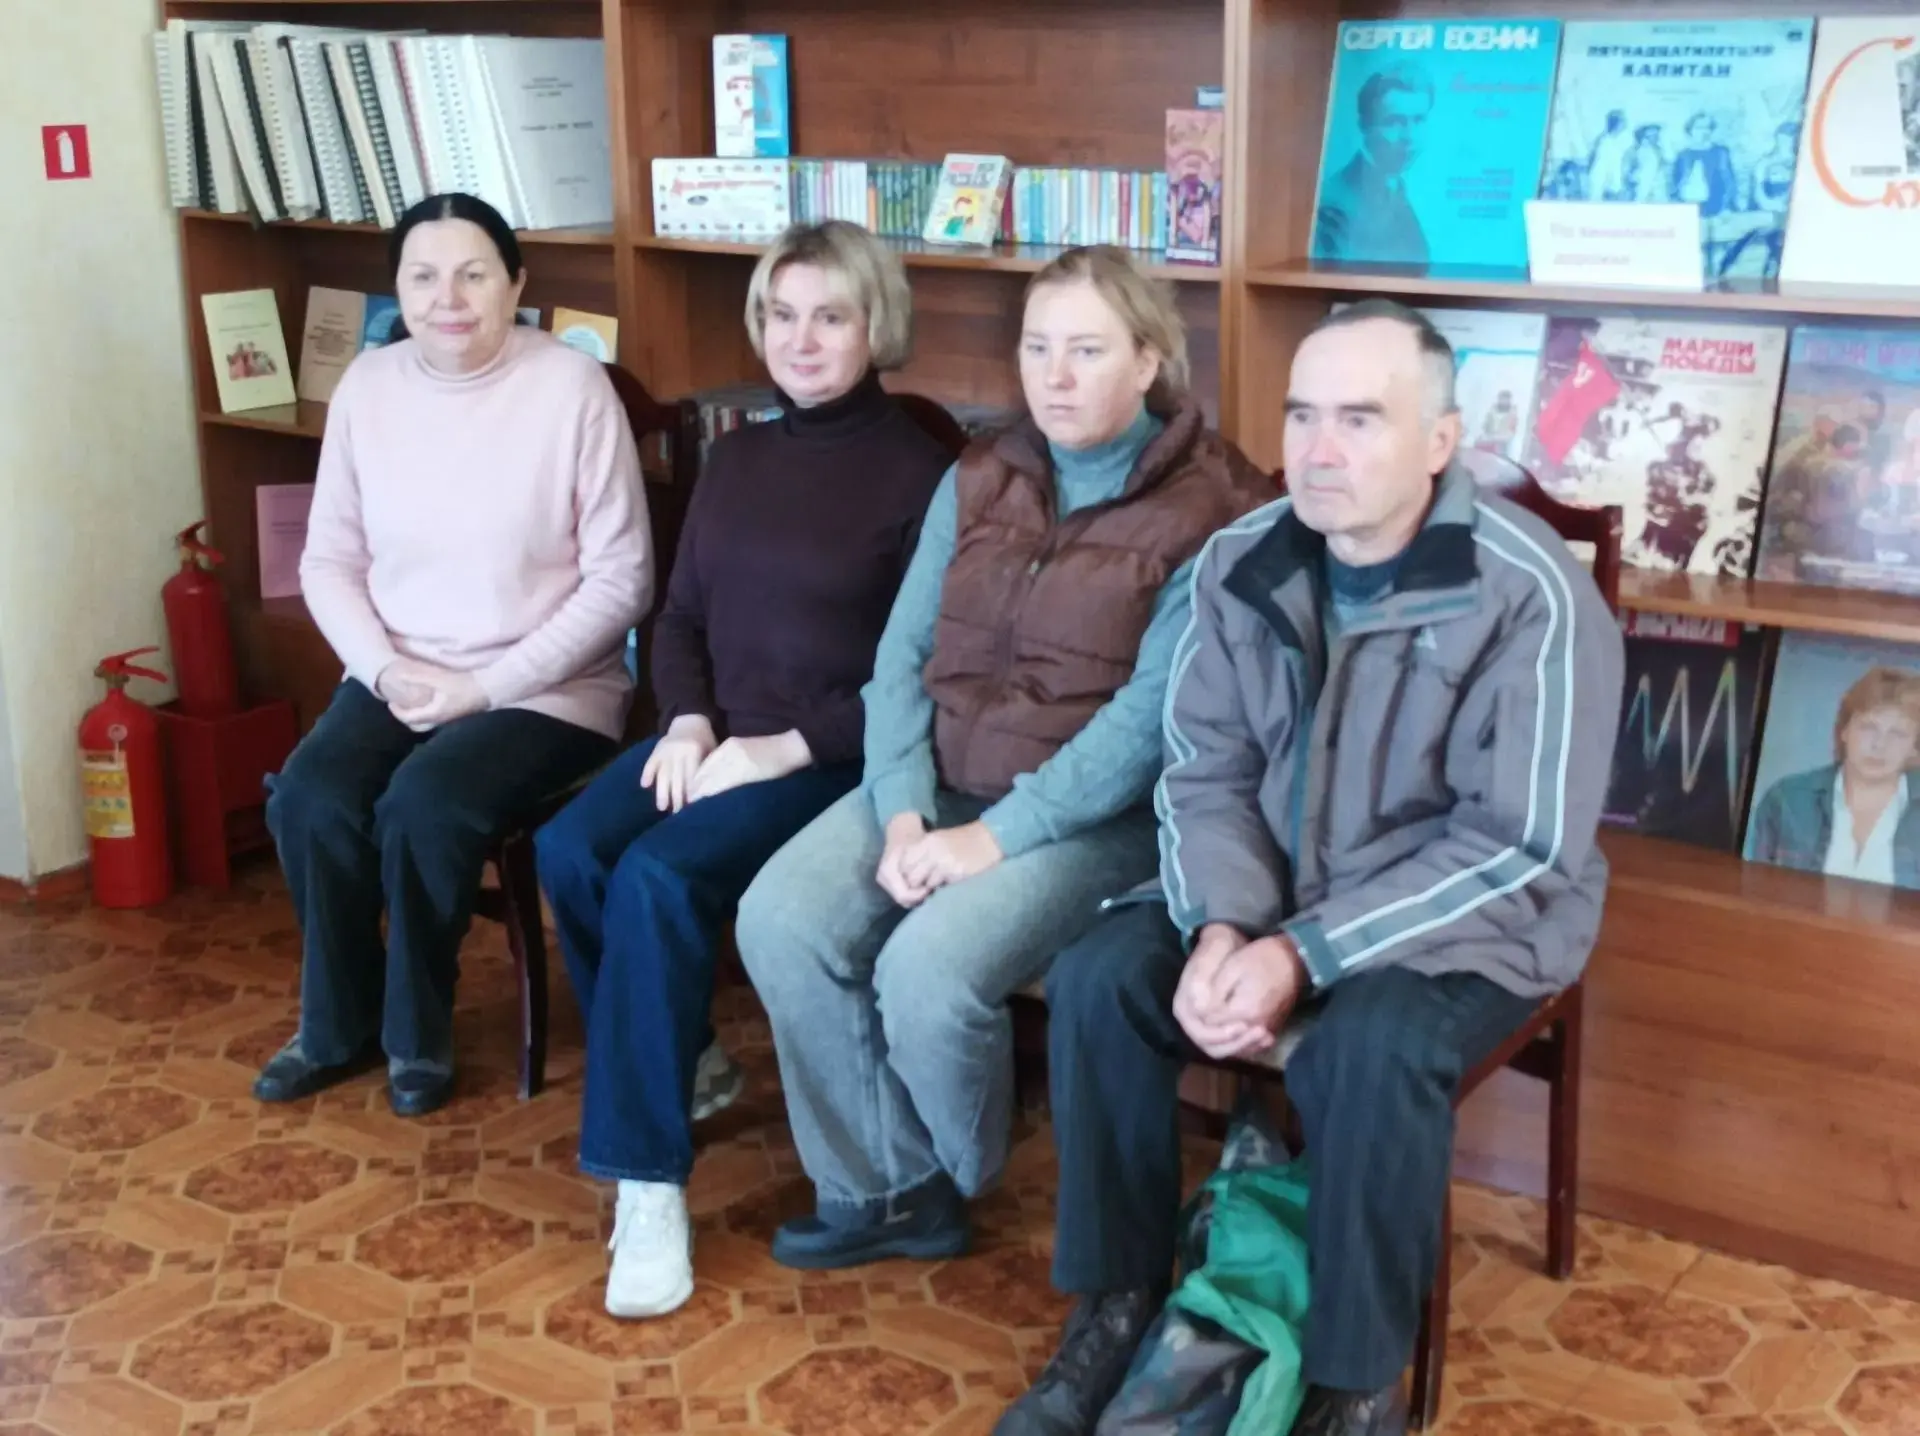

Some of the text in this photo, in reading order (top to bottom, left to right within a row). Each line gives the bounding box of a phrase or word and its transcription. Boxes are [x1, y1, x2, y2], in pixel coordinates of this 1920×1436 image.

[1344, 24, 1538, 51] СЕРГЕЙ ЕСЕНИН
[1622, 63, 1731, 78] КАПИТАН
[1662, 337, 1754, 356] МАРШИ
[1660, 353, 1756, 374] ПОБЕДЫ
